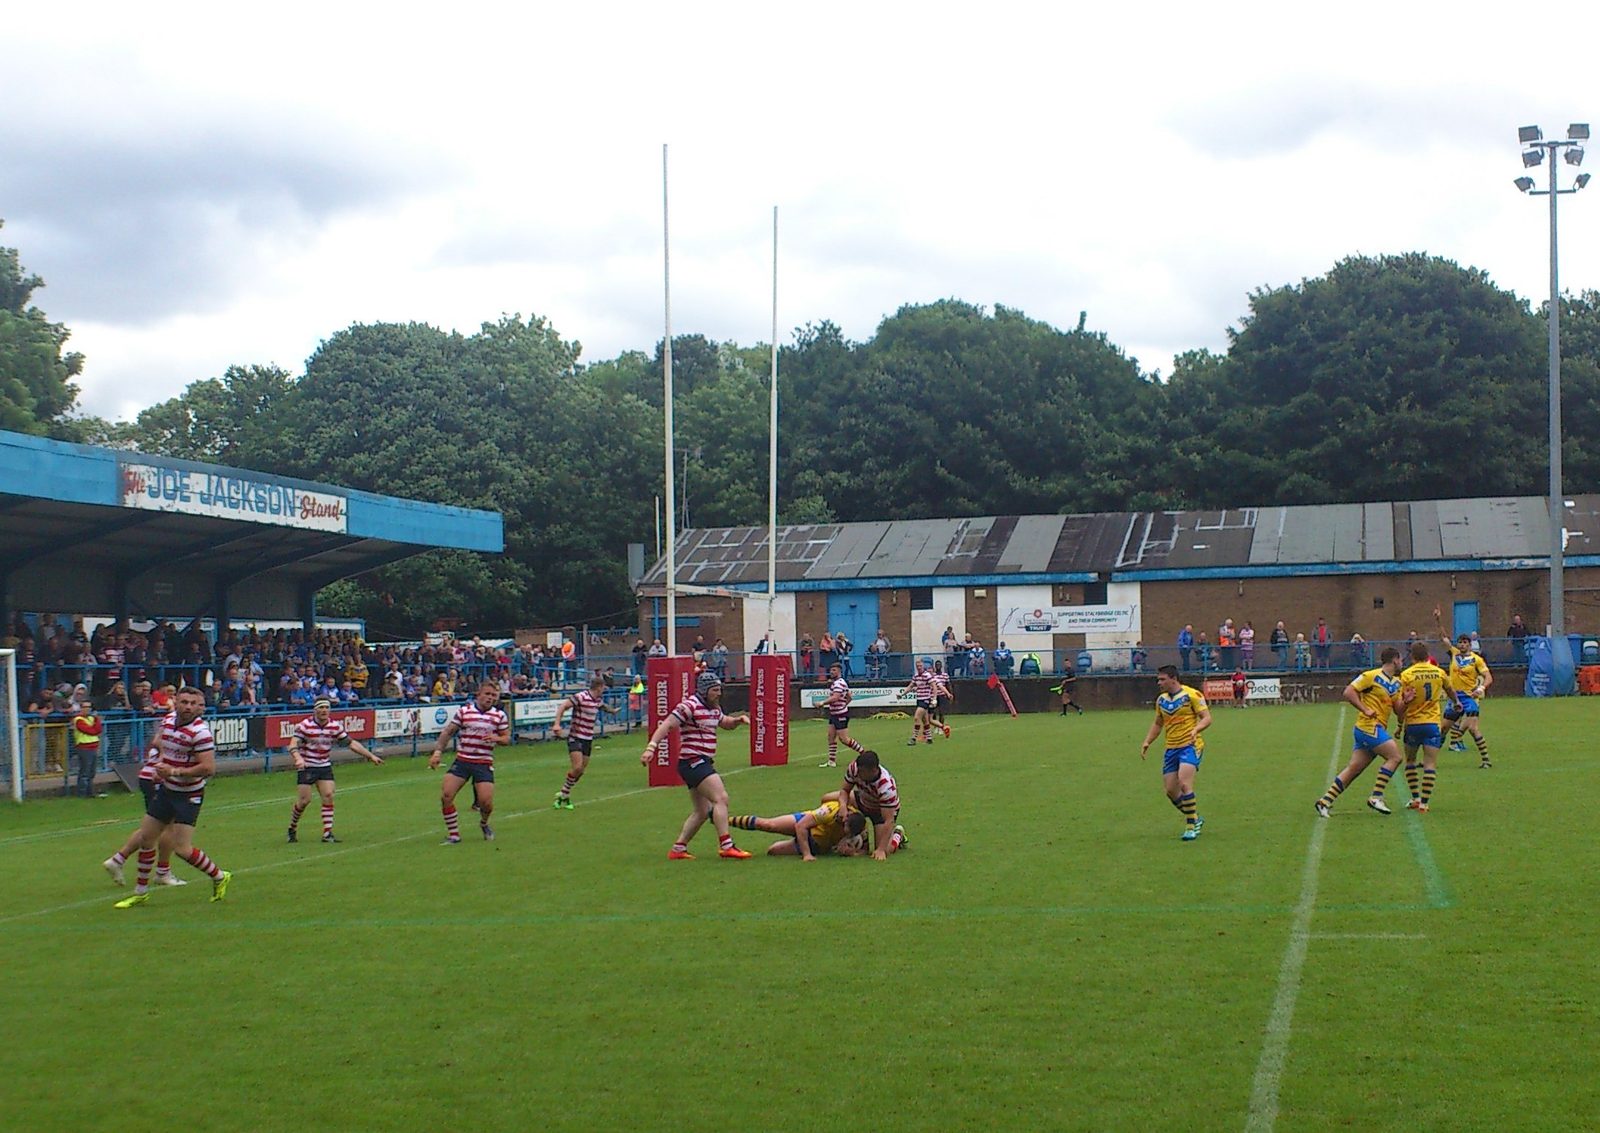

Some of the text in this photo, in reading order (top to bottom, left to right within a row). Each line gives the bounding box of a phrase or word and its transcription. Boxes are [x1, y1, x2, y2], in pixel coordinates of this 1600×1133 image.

[149, 467, 191, 503] JOE
[200, 475, 296, 517] JACKSON
[300, 494, 344, 521] Stand
[1415, 673, 1440, 681] ATKIN
[1423, 682, 1433, 702] 1
[345, 716, 365, 732] Cider
[657, 680, 669, 766] PROR CIDER
[755, 668, 765, 753] Kingstone Press
[777, 674, 785, 747] PROPER CIDER
